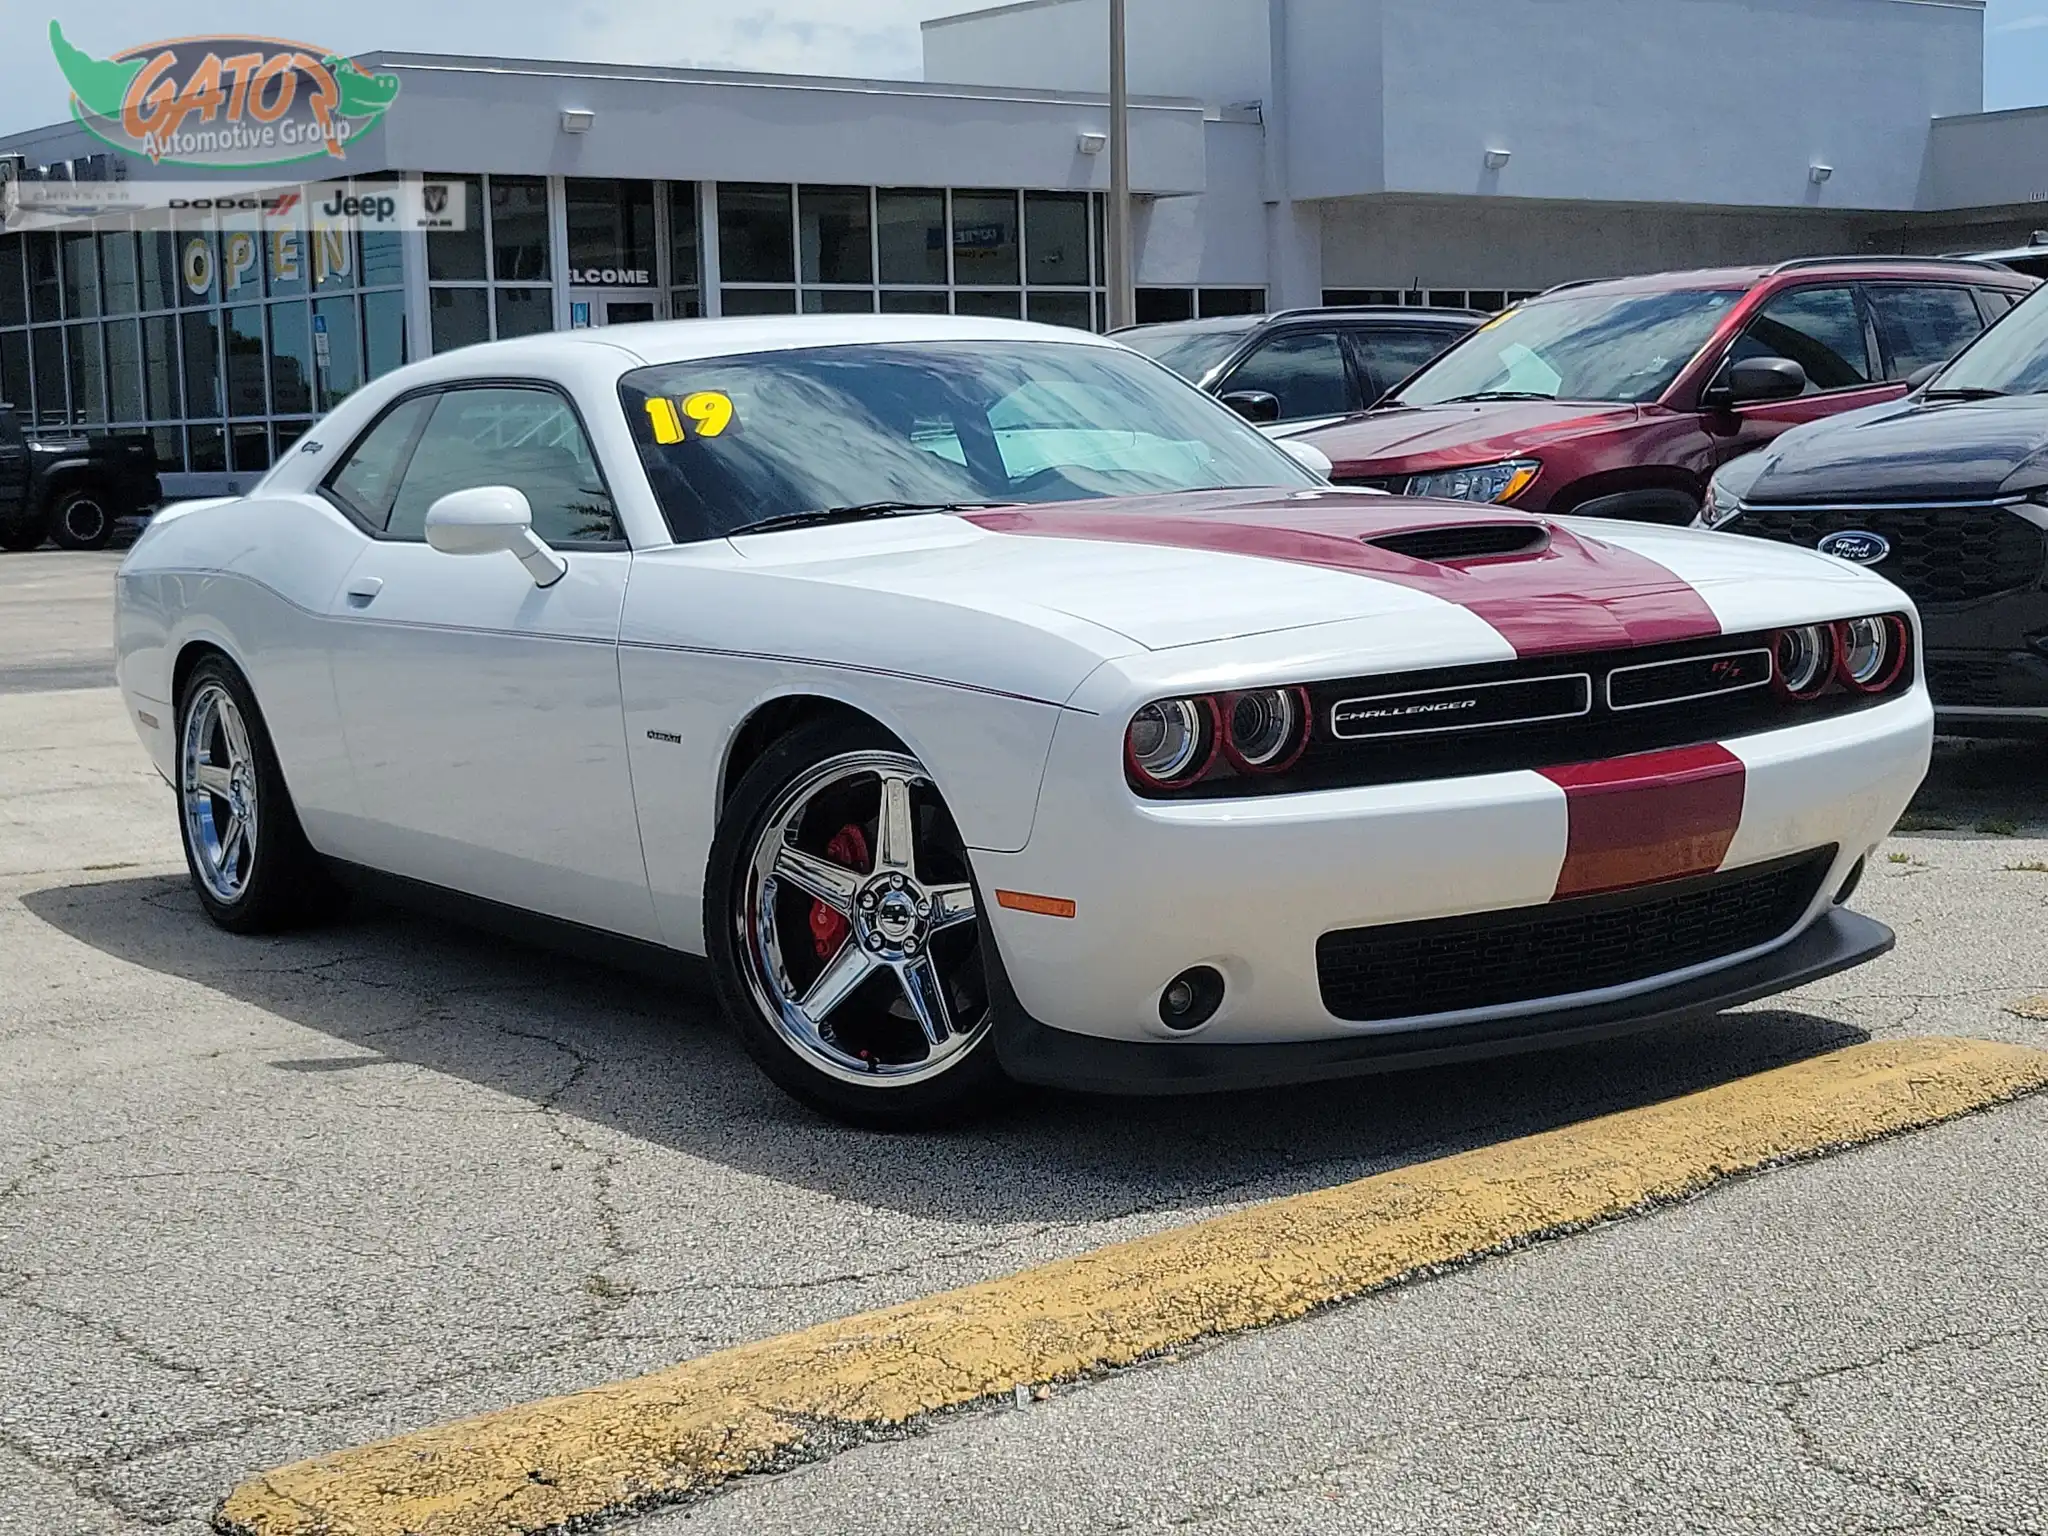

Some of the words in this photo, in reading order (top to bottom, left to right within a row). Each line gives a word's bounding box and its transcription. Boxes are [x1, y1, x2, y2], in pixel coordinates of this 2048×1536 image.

[184, 219, 352, 294] OPEN
[569, 267, 649, 284] LCOME
[645, 391, 733, 445] 19
[1832, 538, 1871, 558] Ford
[1711, 657, 1742, 680] R/T
[1335, 699, 1477, 721] CHALLENGER
